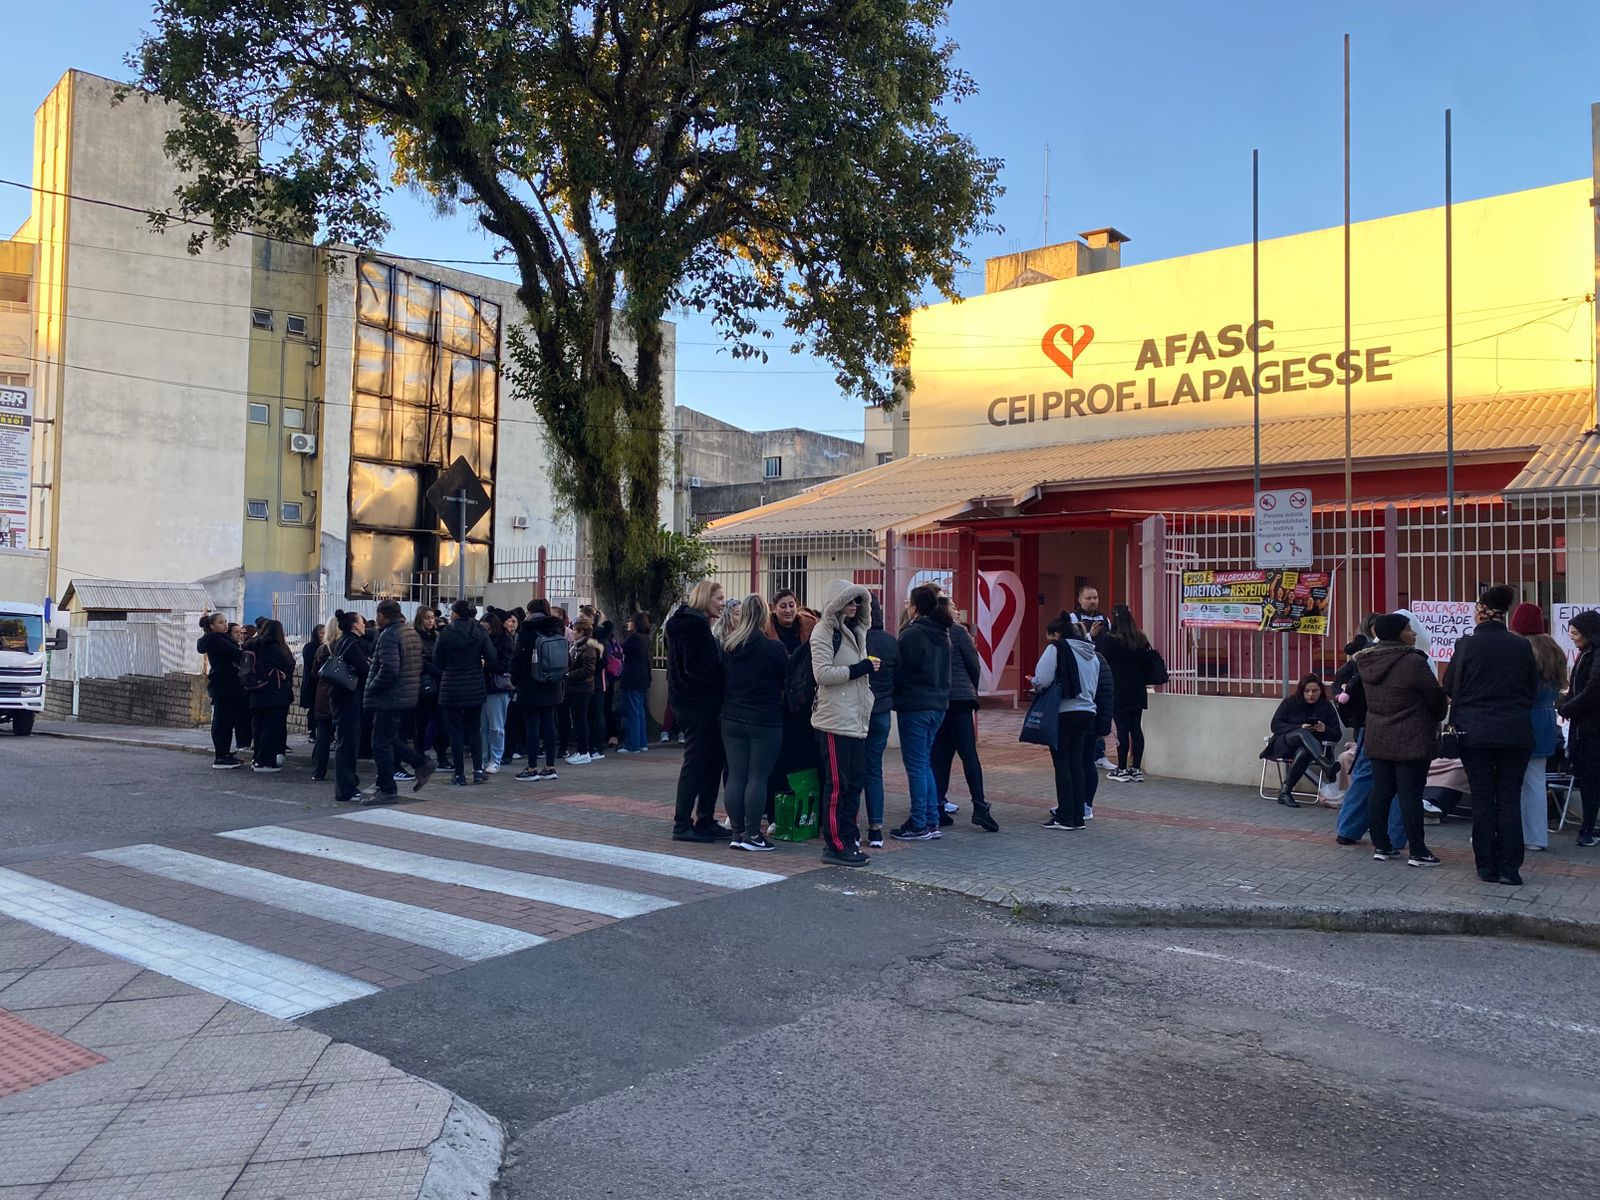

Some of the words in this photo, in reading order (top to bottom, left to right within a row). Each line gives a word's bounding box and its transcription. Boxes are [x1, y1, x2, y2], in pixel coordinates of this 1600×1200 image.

[1134, 319, 1275, 371] AFASC
[0, 390, 25, 405] BR
[987, 393, 1036, 427] CEI
[1187, 573, 1204, 584] PISO
[1216, 571, 1262, 582] VALORIZAÇÃO!
[1184, 584, 1222, 597] DIREITOS
[1230, 583, 1271, 597] RESPEITO!
[1413, 602, 1470, 615] EDUCAÇÃO
[1415, 614, 1472, 625] UALIDADE
[1425, 624, 1458, 636] MEÇA
[1431, 636, 1455, 647] PROF
[1429, 648, 1453, 658] LOR
